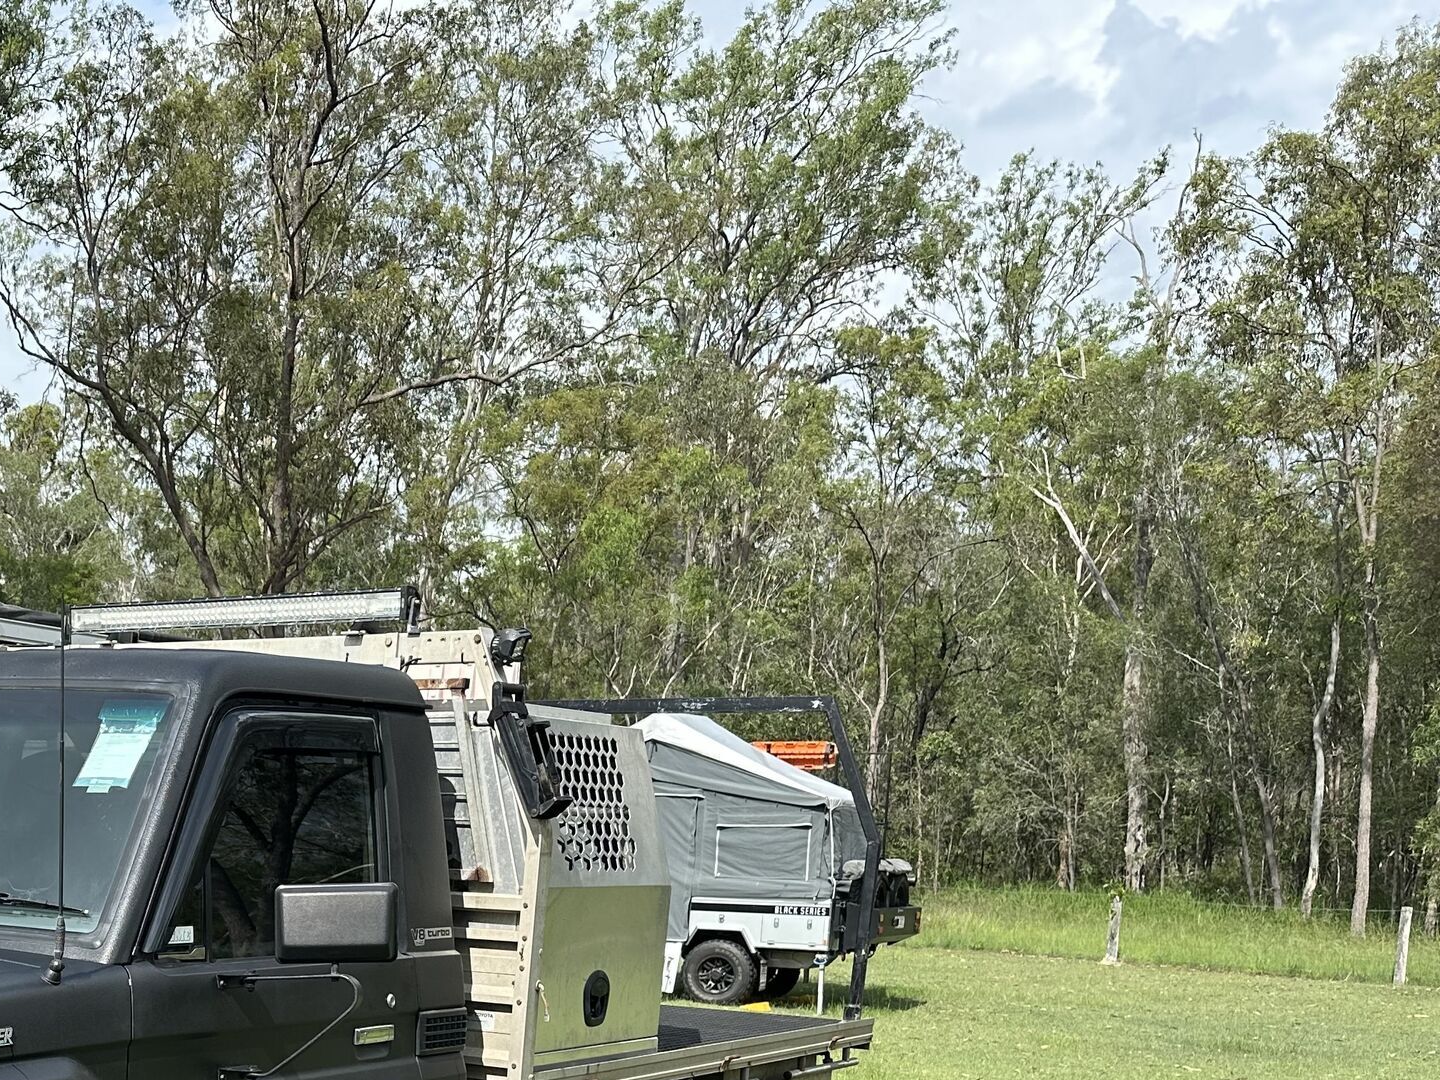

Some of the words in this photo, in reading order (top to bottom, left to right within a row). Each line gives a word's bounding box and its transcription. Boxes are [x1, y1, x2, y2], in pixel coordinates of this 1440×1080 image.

[774, 905, 798, 915] BLACK
[799, 906, 827, 916] SERIES
[411, 928, 426, 940] V8
[427, 929, 450, 938] turbo
